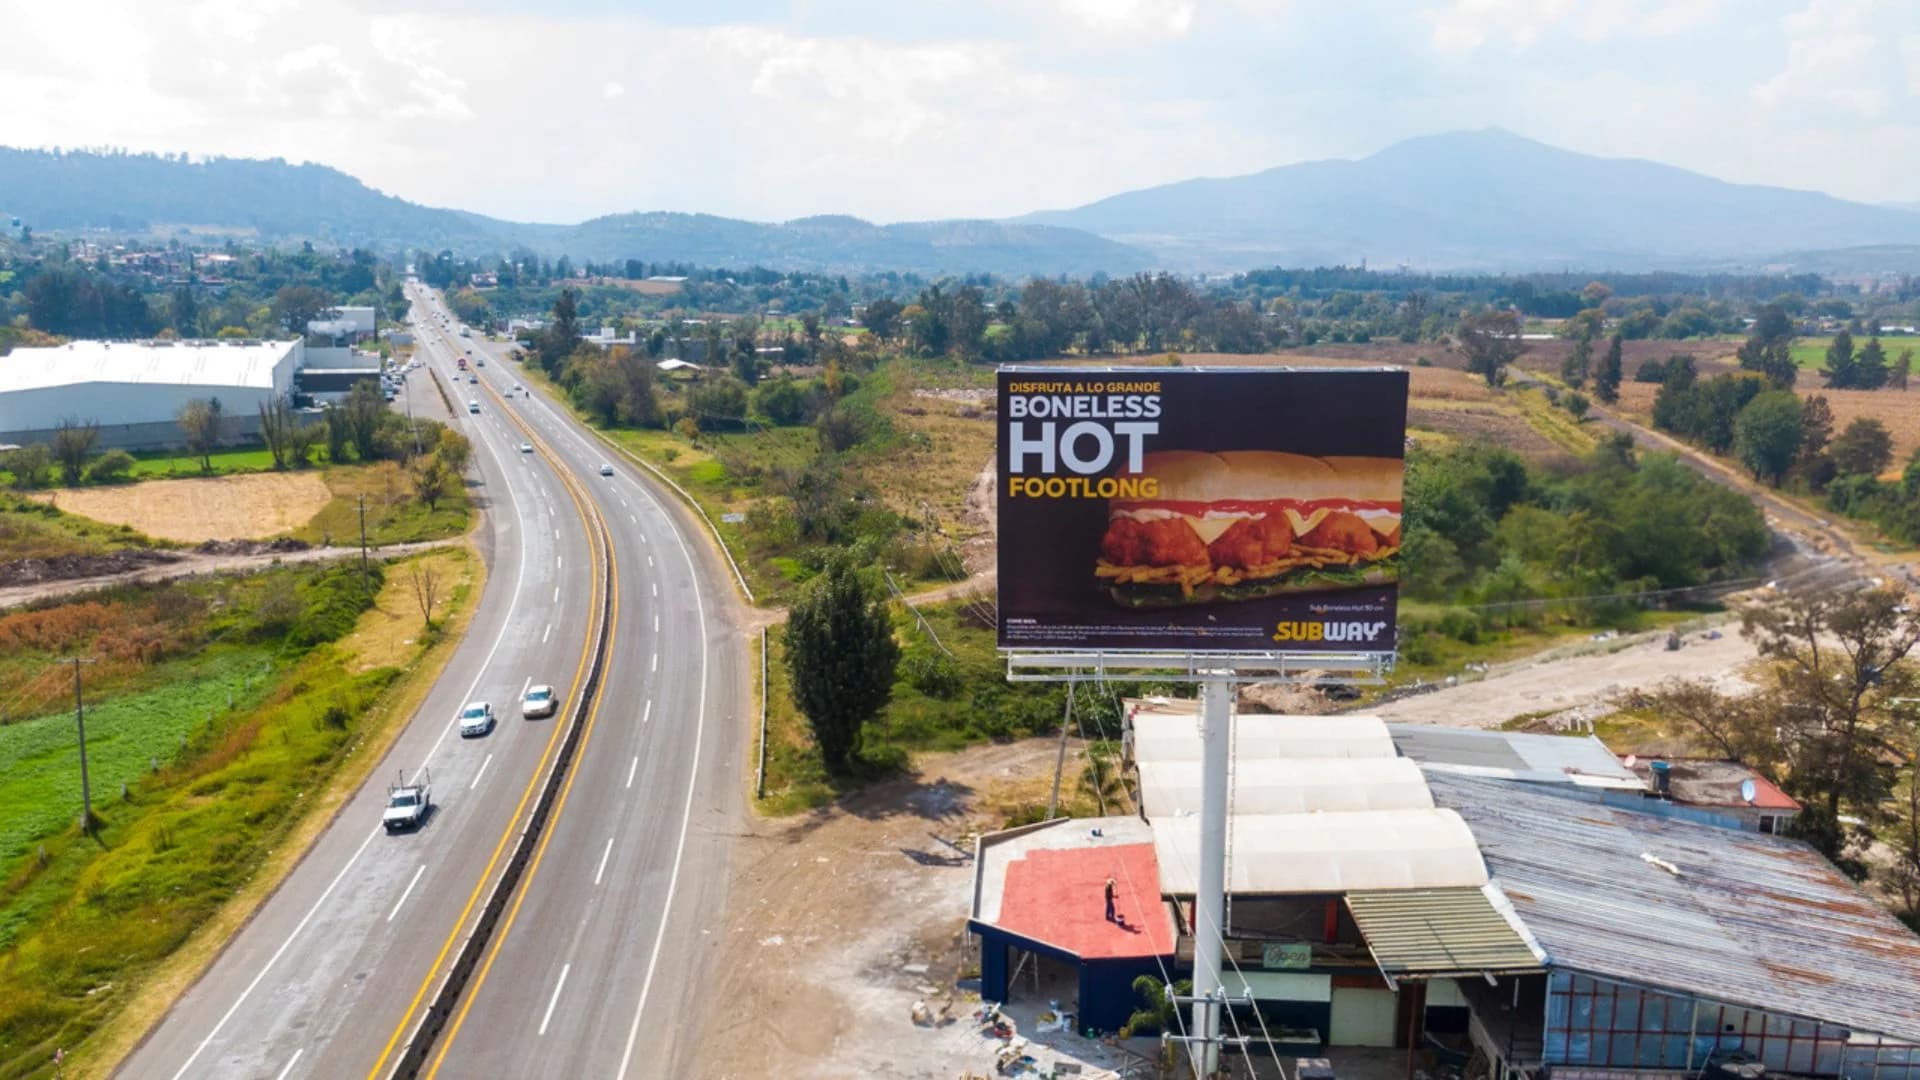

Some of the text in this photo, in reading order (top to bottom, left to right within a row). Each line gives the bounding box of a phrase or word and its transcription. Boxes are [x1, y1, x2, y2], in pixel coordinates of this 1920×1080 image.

[1009, 382, 1161, 393] DISFRUTA A LO GRANDE
[1009, 395, 1162, 418] BONELESS
[1009, 421, 1159, 475] HOT
[1009, 477, 1158, 498] FOOTLONG
[1272, 621, 1387, 641] SUBWAY
